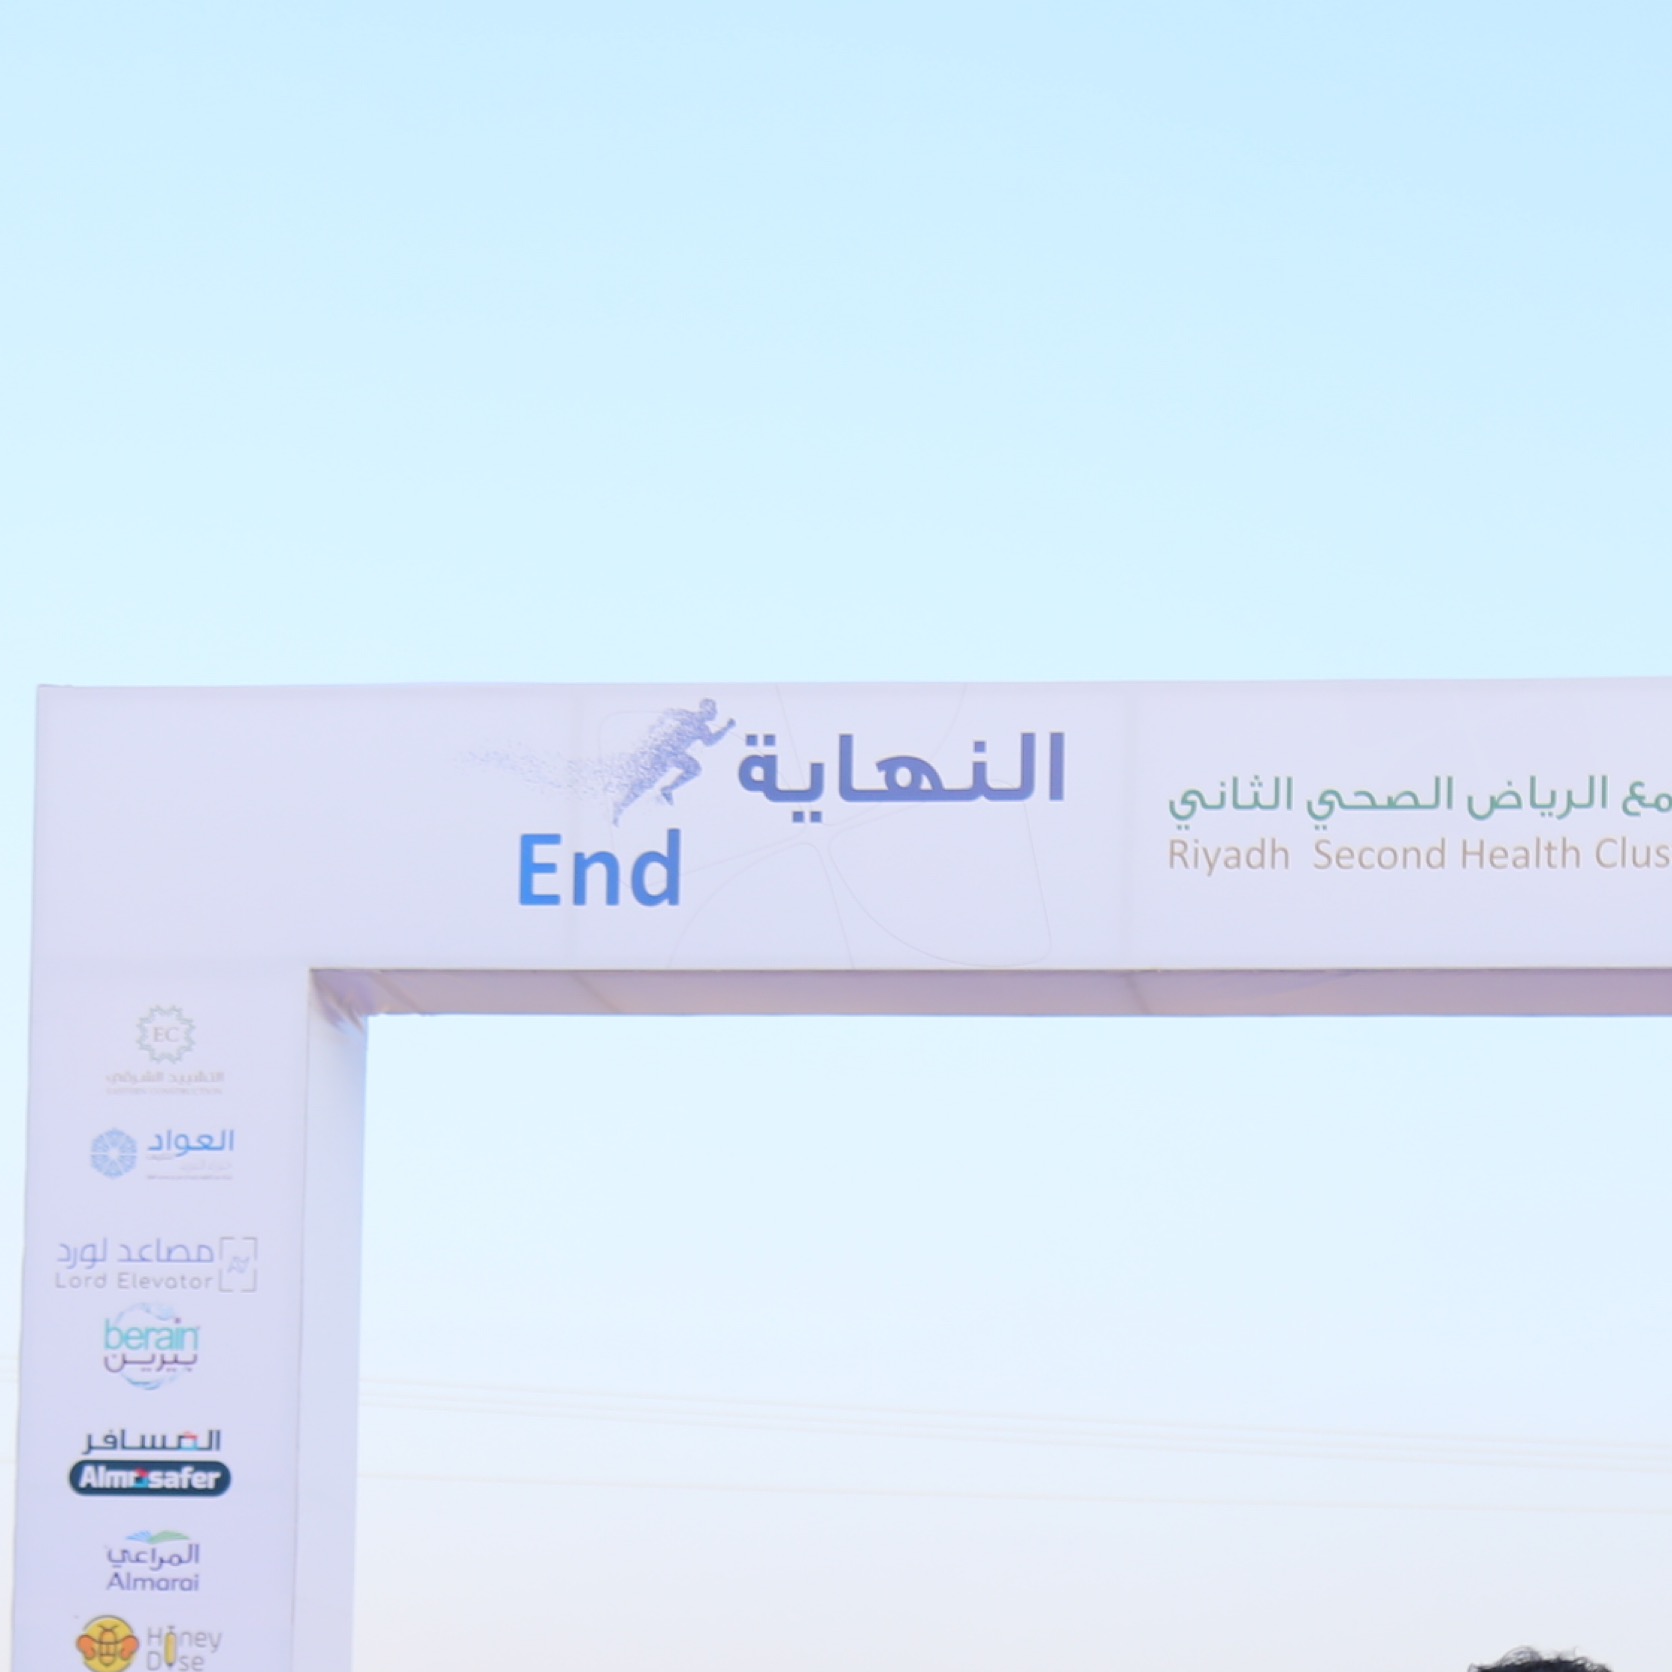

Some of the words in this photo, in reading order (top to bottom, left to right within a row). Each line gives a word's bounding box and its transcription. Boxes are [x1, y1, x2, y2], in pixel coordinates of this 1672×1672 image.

[737, 731, 1066, 825] النهاية
[1168, 775, 1295, 831] الثاني
[1305, 775, 1454, 831] الصحي
[1466, 774, 1609, 822] الرياض
[518, 827, 682, 908] End
[1168, 838, 1291, 876] Riyadh
[1313, 837, 1447, 871] Second
[1460, 836, 1582, 870] Health
[152, 1027, 179, 1043] EC
[147, 1129, 234, 1157] العواد
[57, 1237, 107, 1269] لورد
[117, 1237, 215, 1263] مصاعد
[55, 1272, 107, 1289] Lord
[117, 1272, 214, 1290] Elevator
[104, 1317, 200, 1351] berain
[106, 1544, 200, 1571] المراعي
[106, 1572, 199, 1592] Almarai
